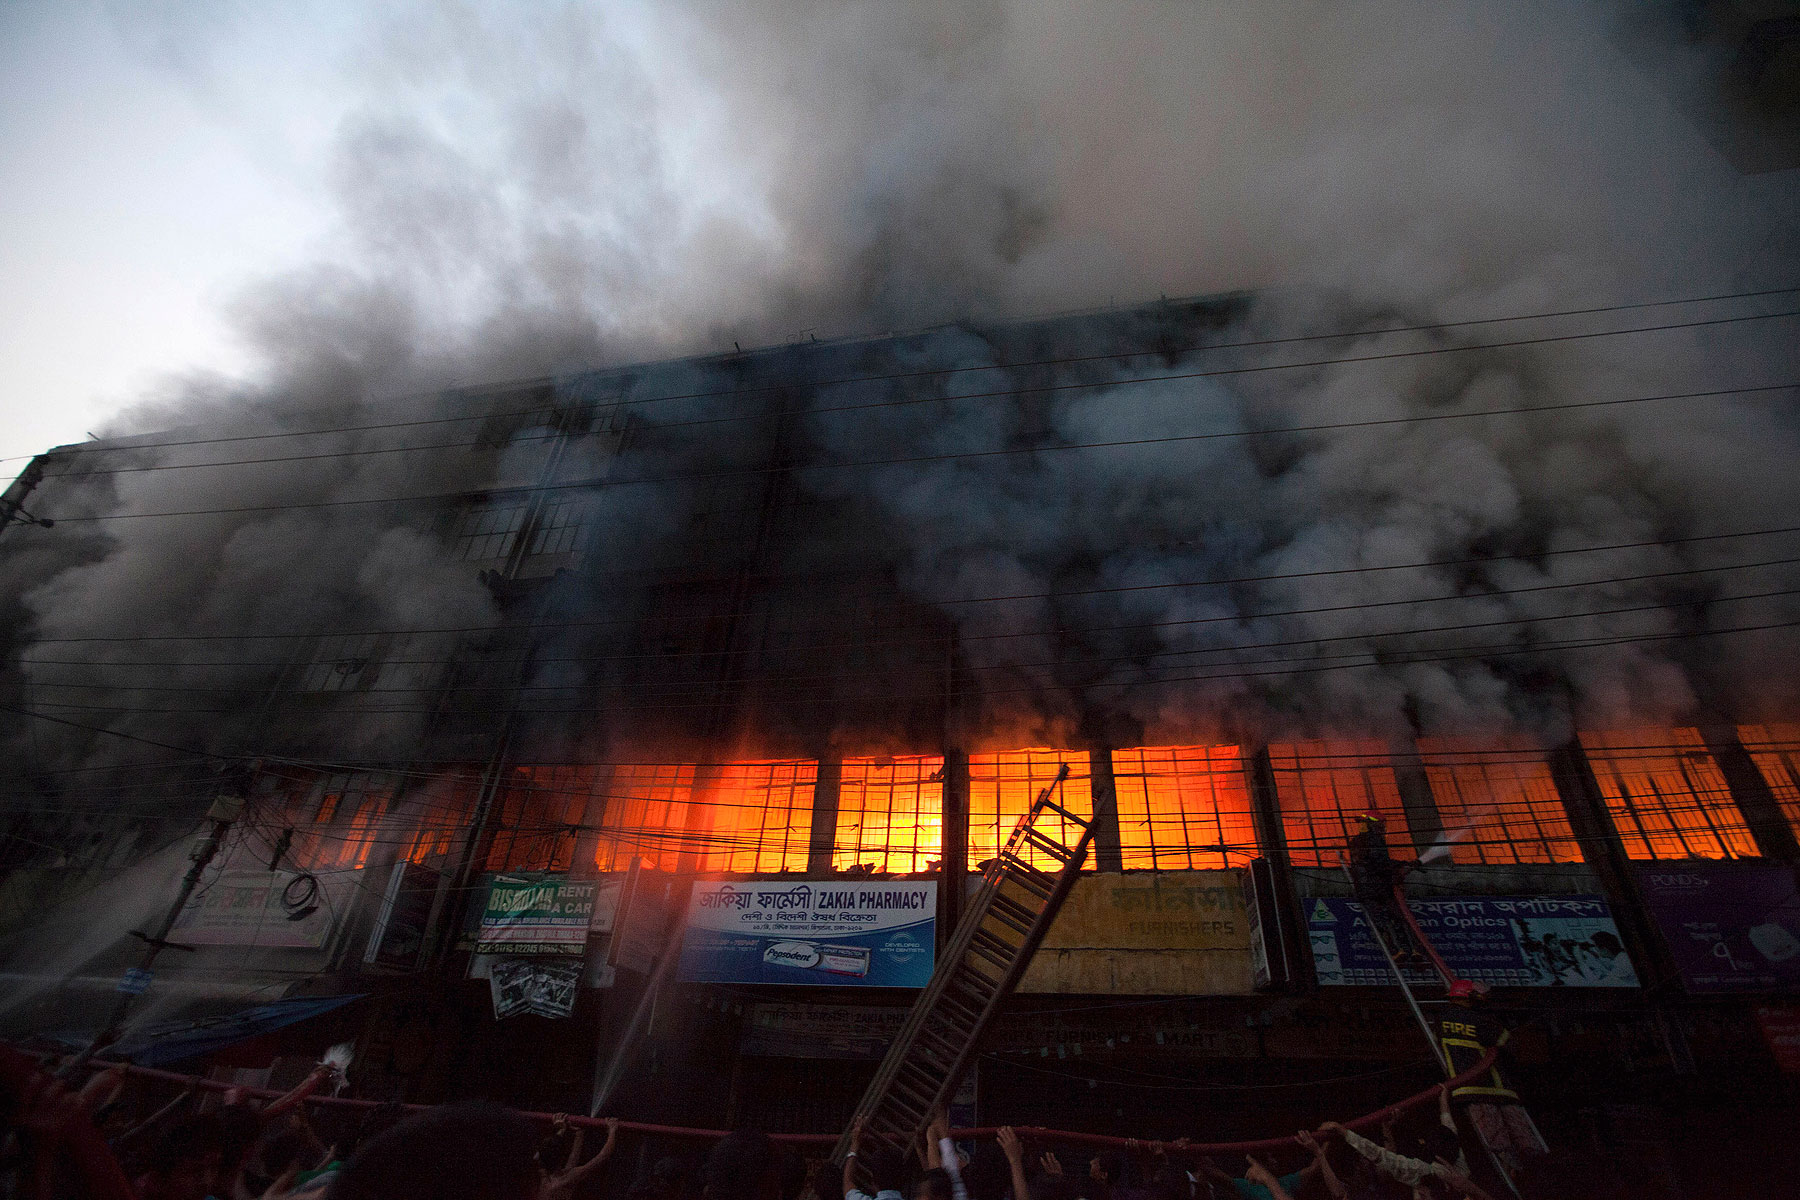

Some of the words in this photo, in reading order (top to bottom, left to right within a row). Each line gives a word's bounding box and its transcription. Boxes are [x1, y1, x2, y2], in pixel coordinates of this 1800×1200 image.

[557, 886, 592, 898] RENT
[700, 886, 753, 909] জাকিয়া
[818, 891, 856, 910] ZAKIA
[859, 891, 928, 910] PHARMACY
[551, 902, 561, 914] A
[565, 902, 592, 914] CAR
[741, 911, 763, 921] দেশী
[765, 913, 773, 921] ও
[776, 911, 807, 921] বিদেশী
[839, 911, 877, 922] বিক্রেতা
[1443, 916, 1507, 929] Optics
[1129, 921, 1235, 936] FURNISHERS
[767, 948, 812, 962] Pepsodent
[1441, 1020, 1478, 1038] FIRE
[1163, 1030, 1217, 1048] MART
